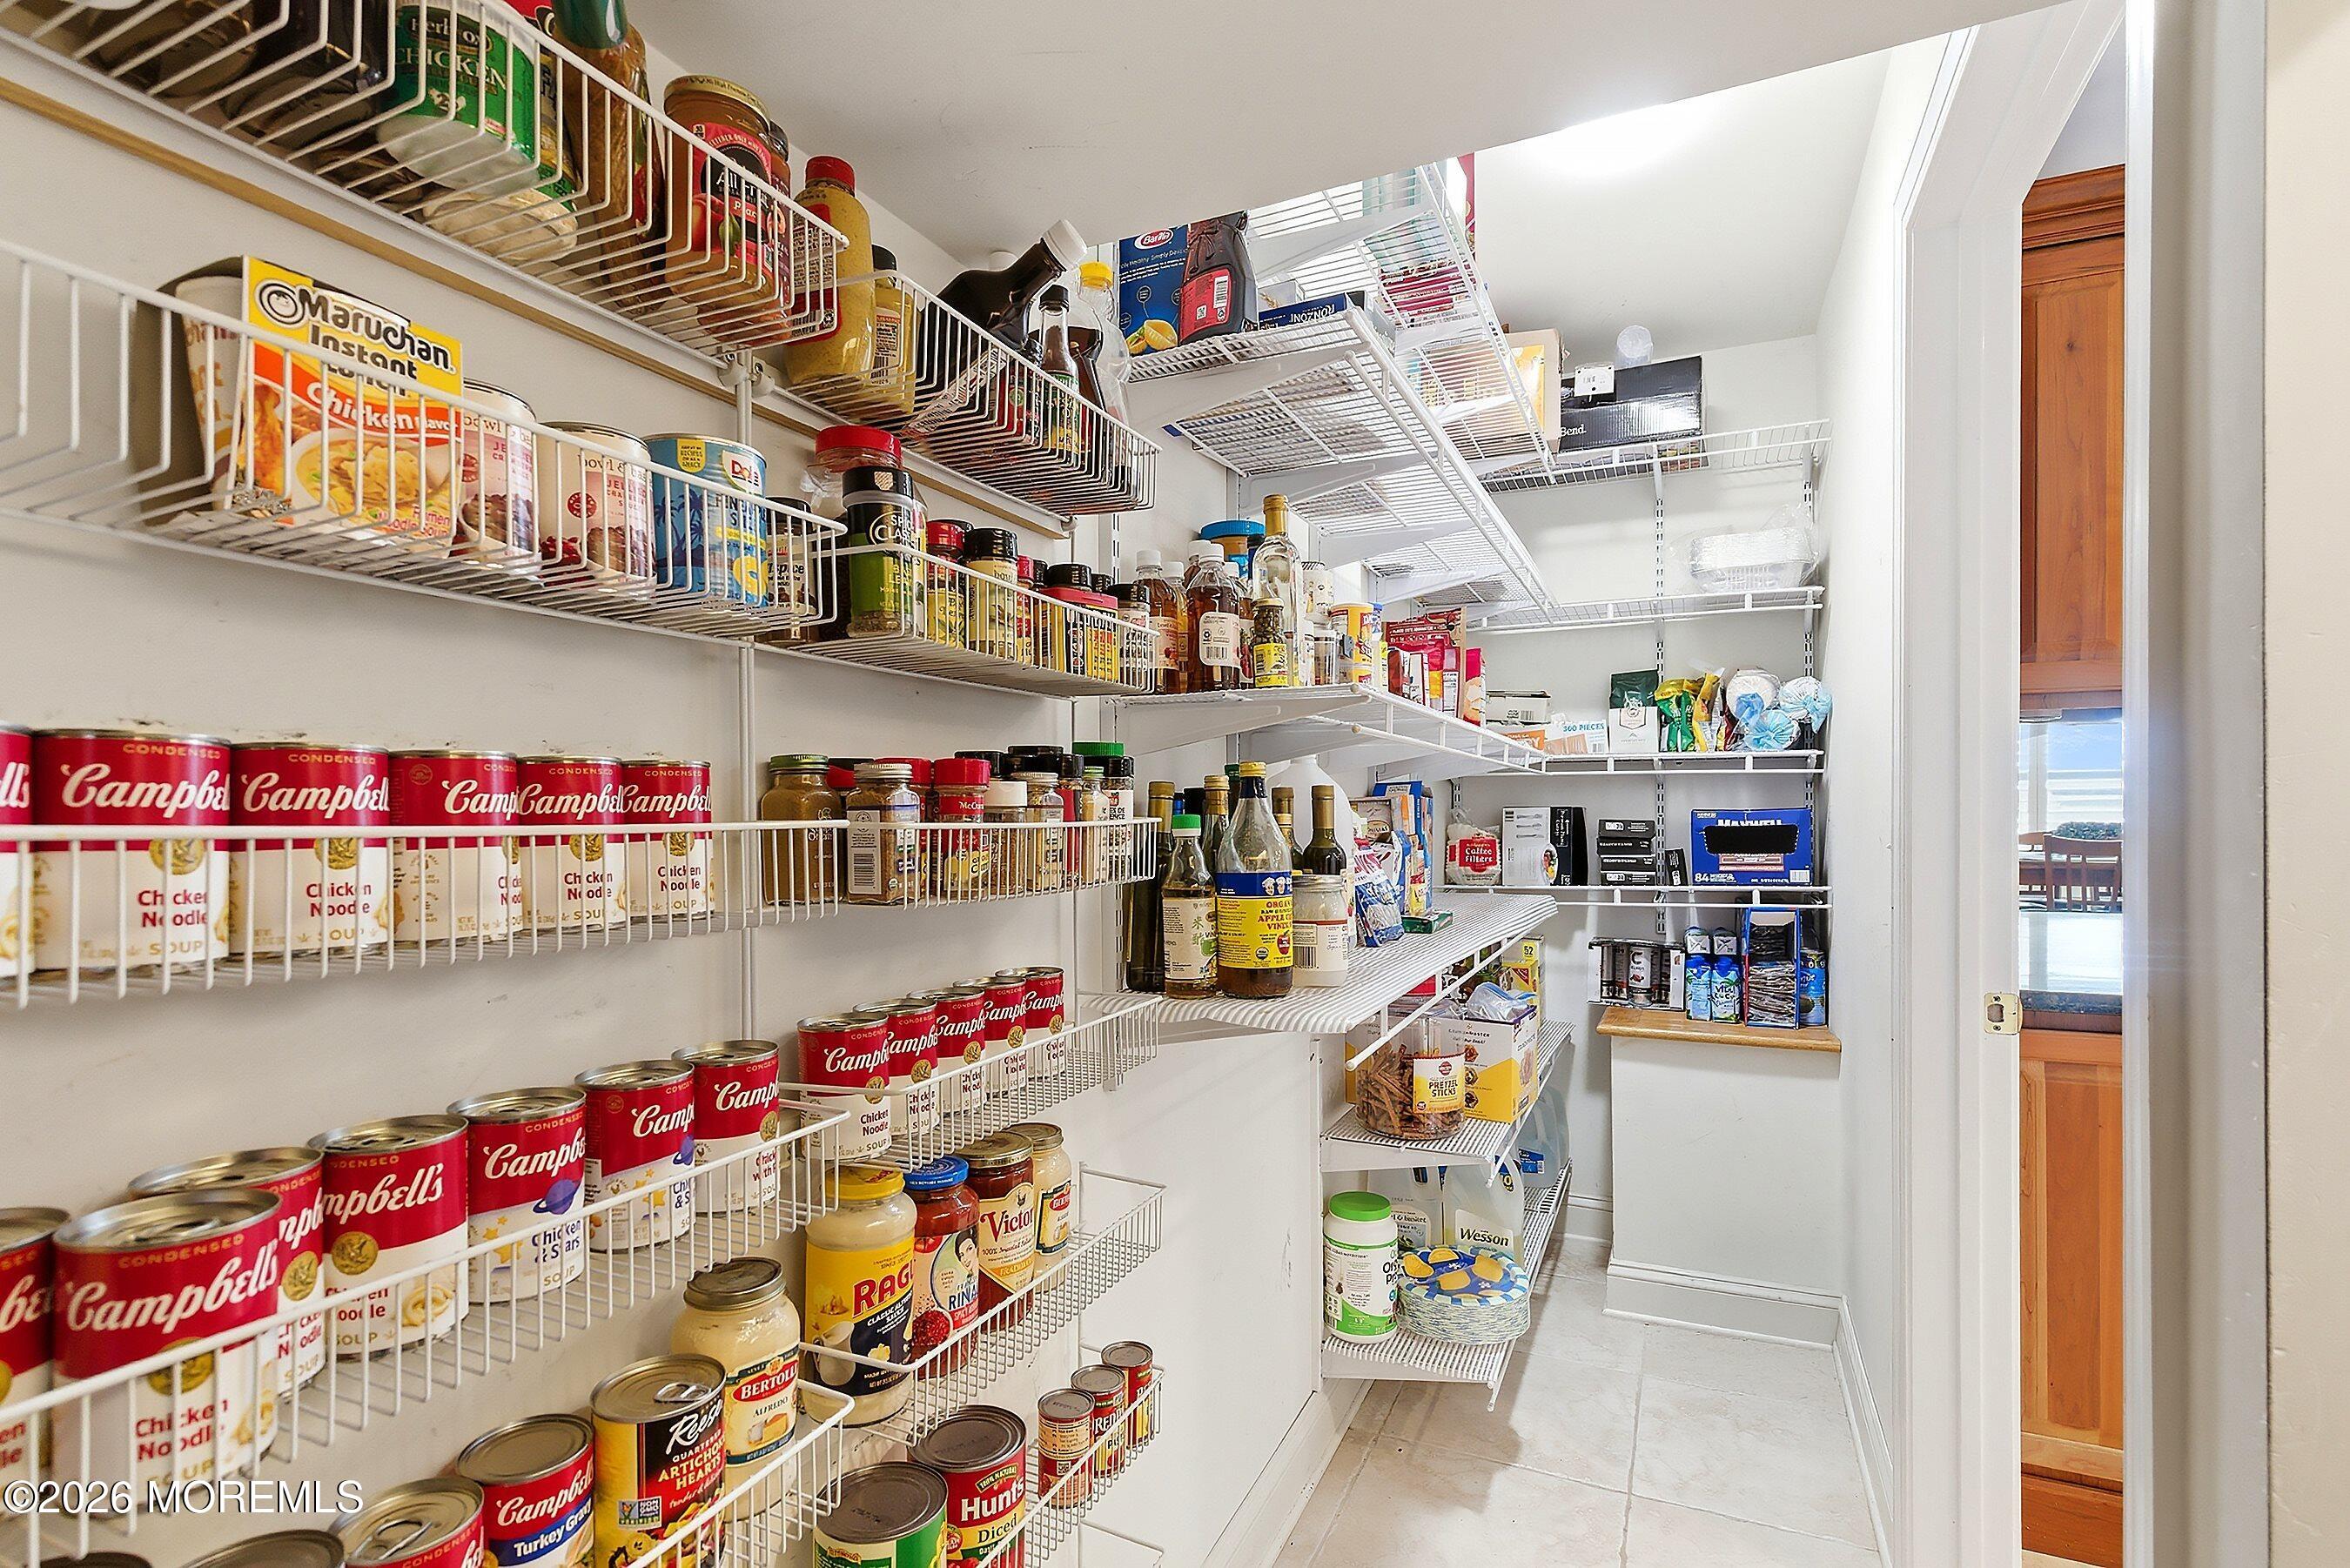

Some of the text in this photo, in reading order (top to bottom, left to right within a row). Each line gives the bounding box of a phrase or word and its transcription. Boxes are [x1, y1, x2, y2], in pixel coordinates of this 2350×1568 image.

[1143, 231, 1171, 245] Barilla
[299, 286, 453, 371] Maruchan
[310, 324, 417, 380] Instant
[1579, 722, 1605, 731] PIECES
[123, 743, 222, 761] CONDENSED
[288, 754, 376, 766] CONDENSED
[548, 767, 614, 776] CONDENSED
[1428, 1079, 1459, 1089] PRETZEL
[1431, 1088, 1457, 1098] STICKS
[860, 1109, 889, 1124] Chicken
[862, 1122, 889, 1136] Noodle
[1460, 1227, 1509, 1247] Wesson
[118, 1234, 245, 1268] CONDENSED
[753, 1397, 789, 1417] ALFREDO
[978, 1512, 1017, 1544] Diced
[514, 1524, 565, 1558] Turkey
